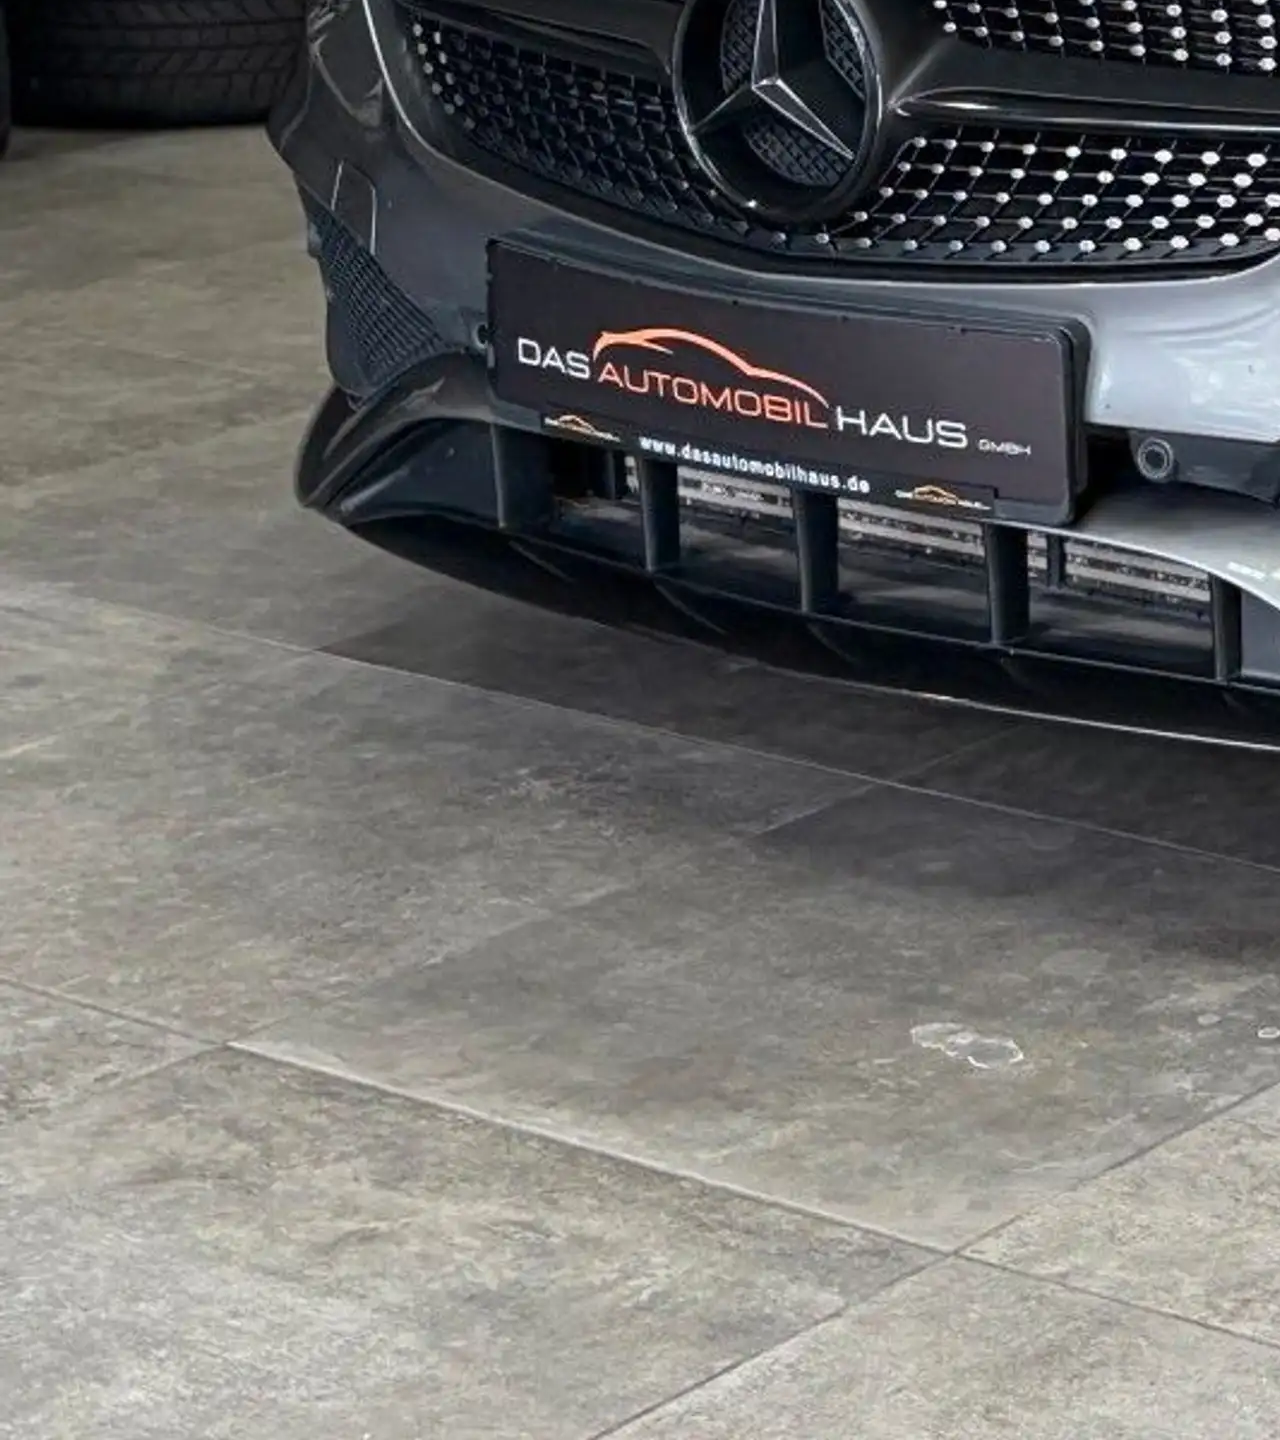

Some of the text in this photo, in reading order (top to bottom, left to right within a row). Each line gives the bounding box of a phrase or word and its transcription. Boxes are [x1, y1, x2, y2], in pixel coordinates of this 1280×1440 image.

[516, 336, 591, 379] DAS
[597, 361, 829, 429] AUTOMOBIL
[835, 405, 969, 449] HAUS
[638, 436, 871, 494] www.dasautomobilhaus.de
